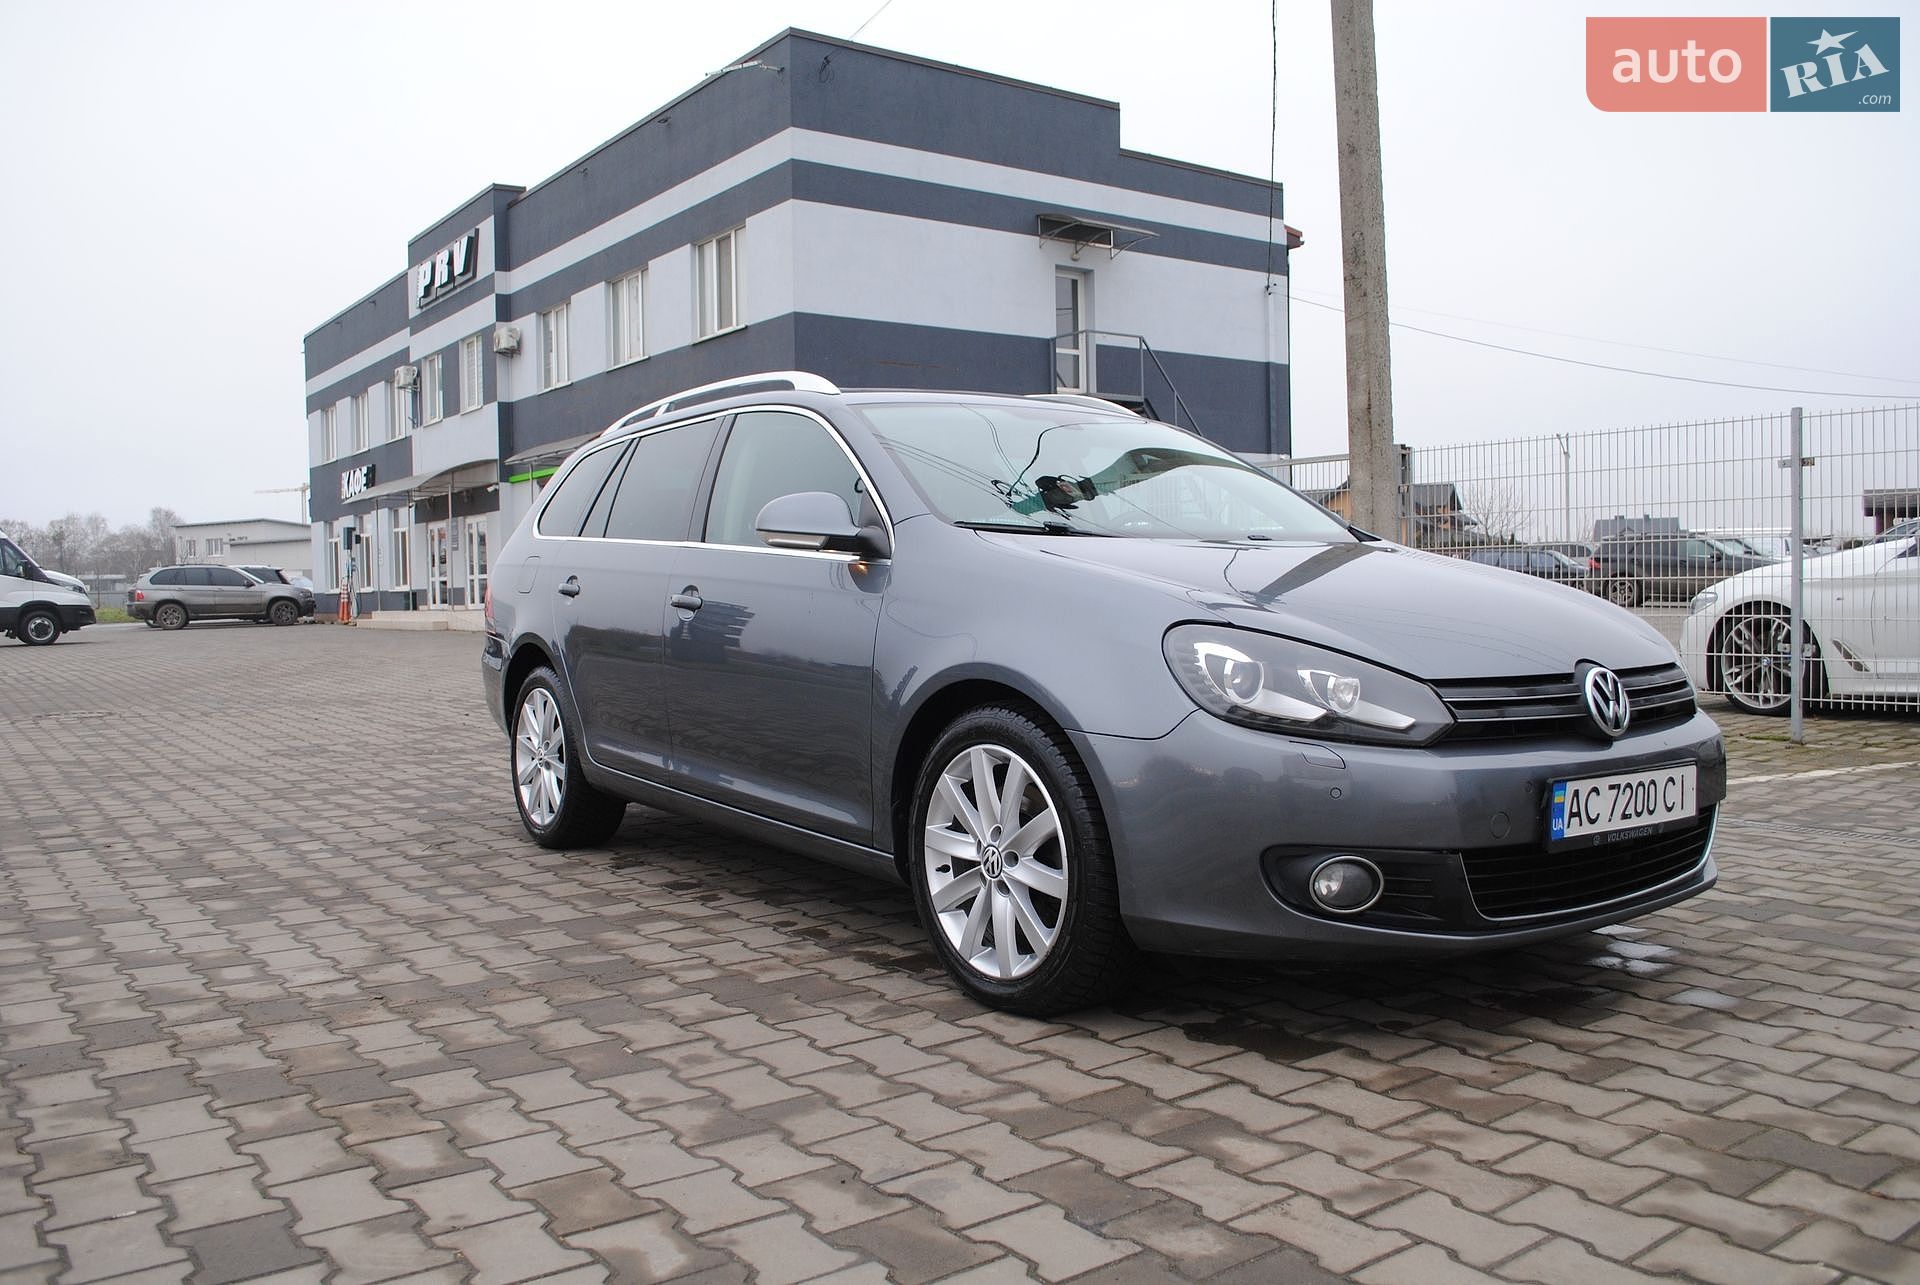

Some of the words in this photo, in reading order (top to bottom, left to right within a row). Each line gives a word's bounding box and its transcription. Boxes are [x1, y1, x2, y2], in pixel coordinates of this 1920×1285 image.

[417, 235, 470, 299] PRV
[1566, 786, 1601, 829] AC
[1608, 779, 1657, 823] 7200
[1663, 774, 1685, 812] CI
[1552, 817, 1564, 830] UA
[1607, 826, 1653, 842] VOLKSWAGEN
